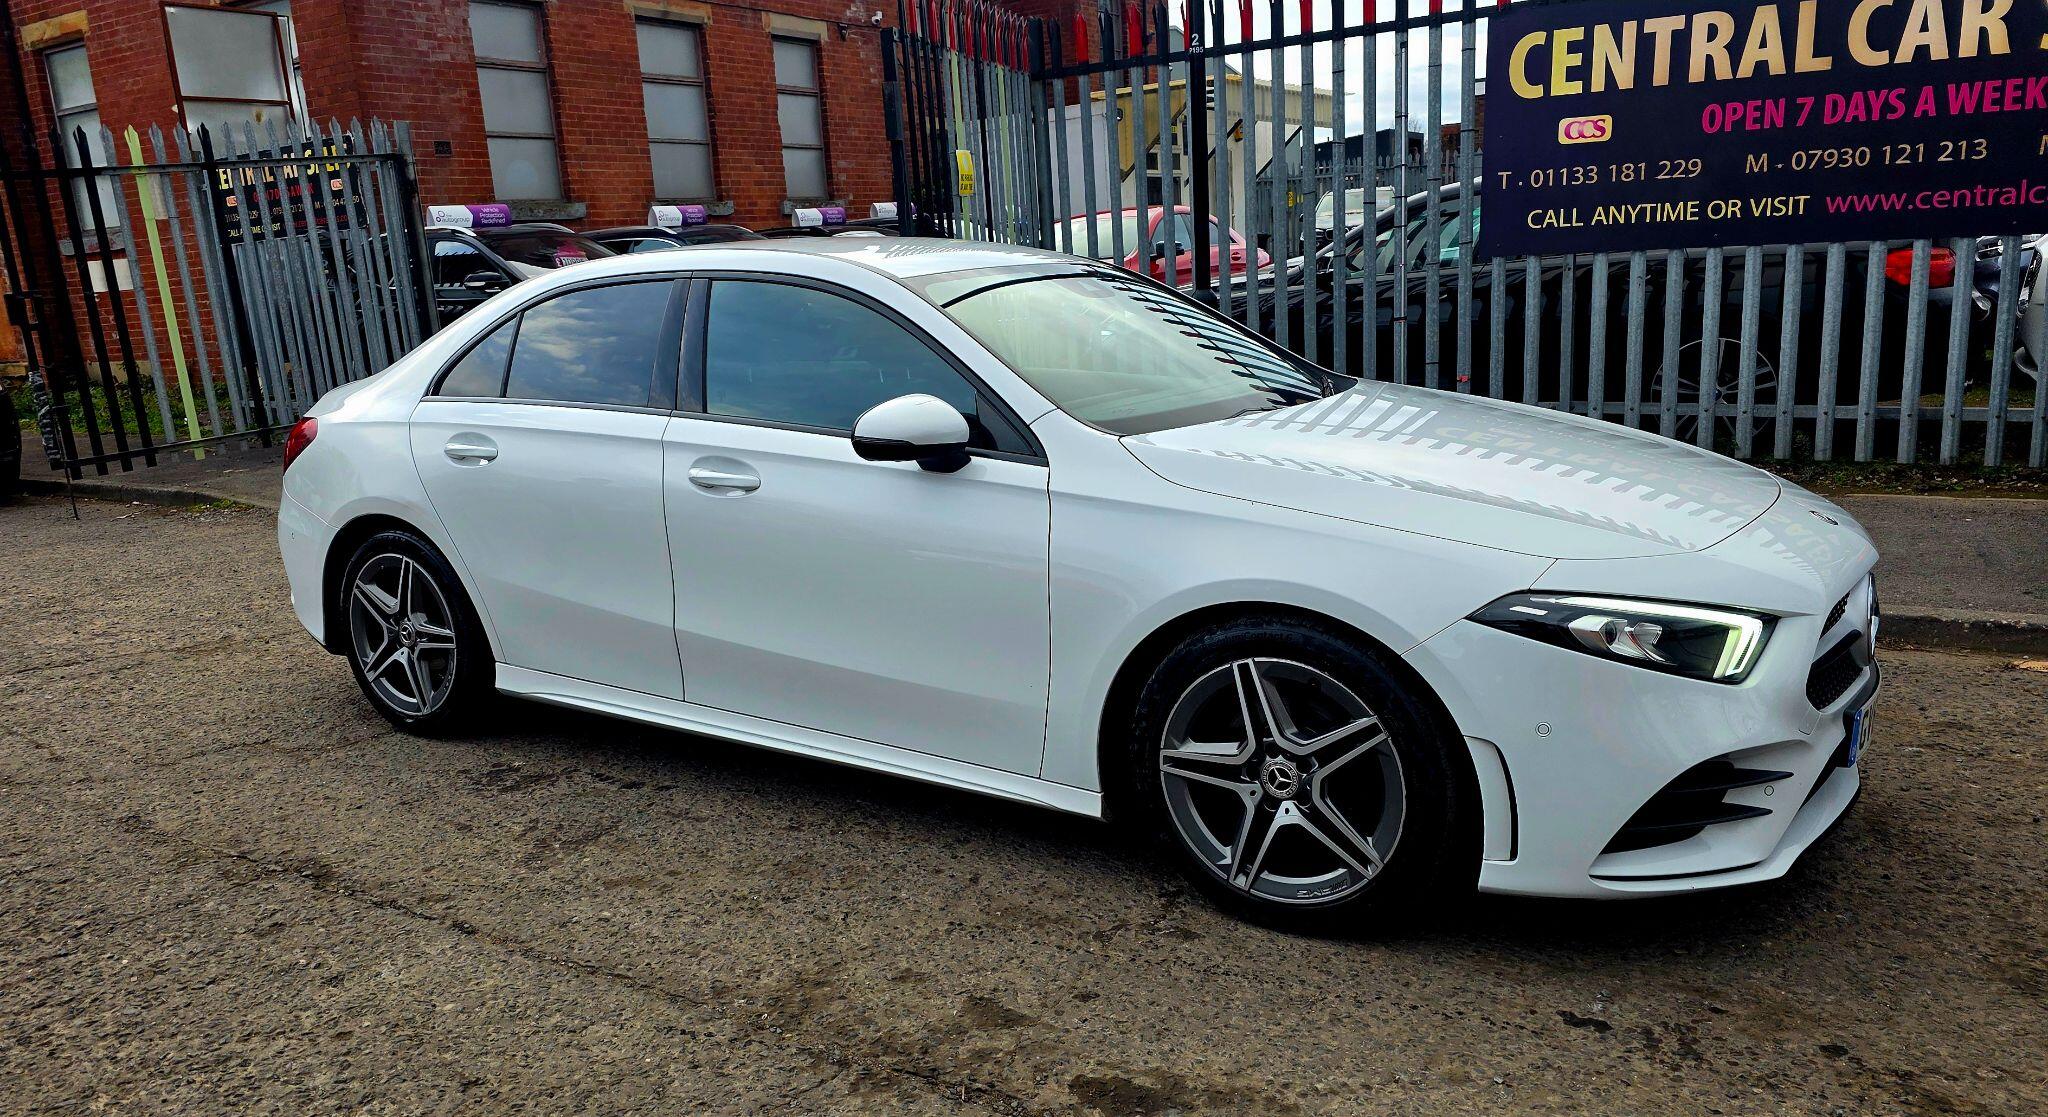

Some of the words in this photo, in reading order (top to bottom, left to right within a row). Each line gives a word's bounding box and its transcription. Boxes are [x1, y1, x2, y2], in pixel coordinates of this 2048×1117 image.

[1191, 33, 1200, 46] 2
[1509, 0, 1833, 99] CENTRAL
[1848, 0, 2012, 67] CAR
[1702, 98, 1785, 134] OPEN
[1796, 97, 1815, 127] 7
[1824, 88, 1906, 125] DAYS
[1913, 86, 1937, 118] A
[1947, 76, 2048, 115] WEEK
[1564, 118, 1607, 141] CCS
[1791, 146, 1871, 171] 07930
[1882, 143, 1925, 165] 121
[1937, 138, 1988, 162] 213
[1530, 165, 1599, 188] 01133
[1608, 162, 1647, 182] 181
[1654, 158, 1703, 180] 229
[1527, 208, 1584, 229] CALL
[1591, 201, 1700, 226] ANYTIME
[1707, 199, 1742, 220] OR
[1750, 195, 1811, 217] VISIT
